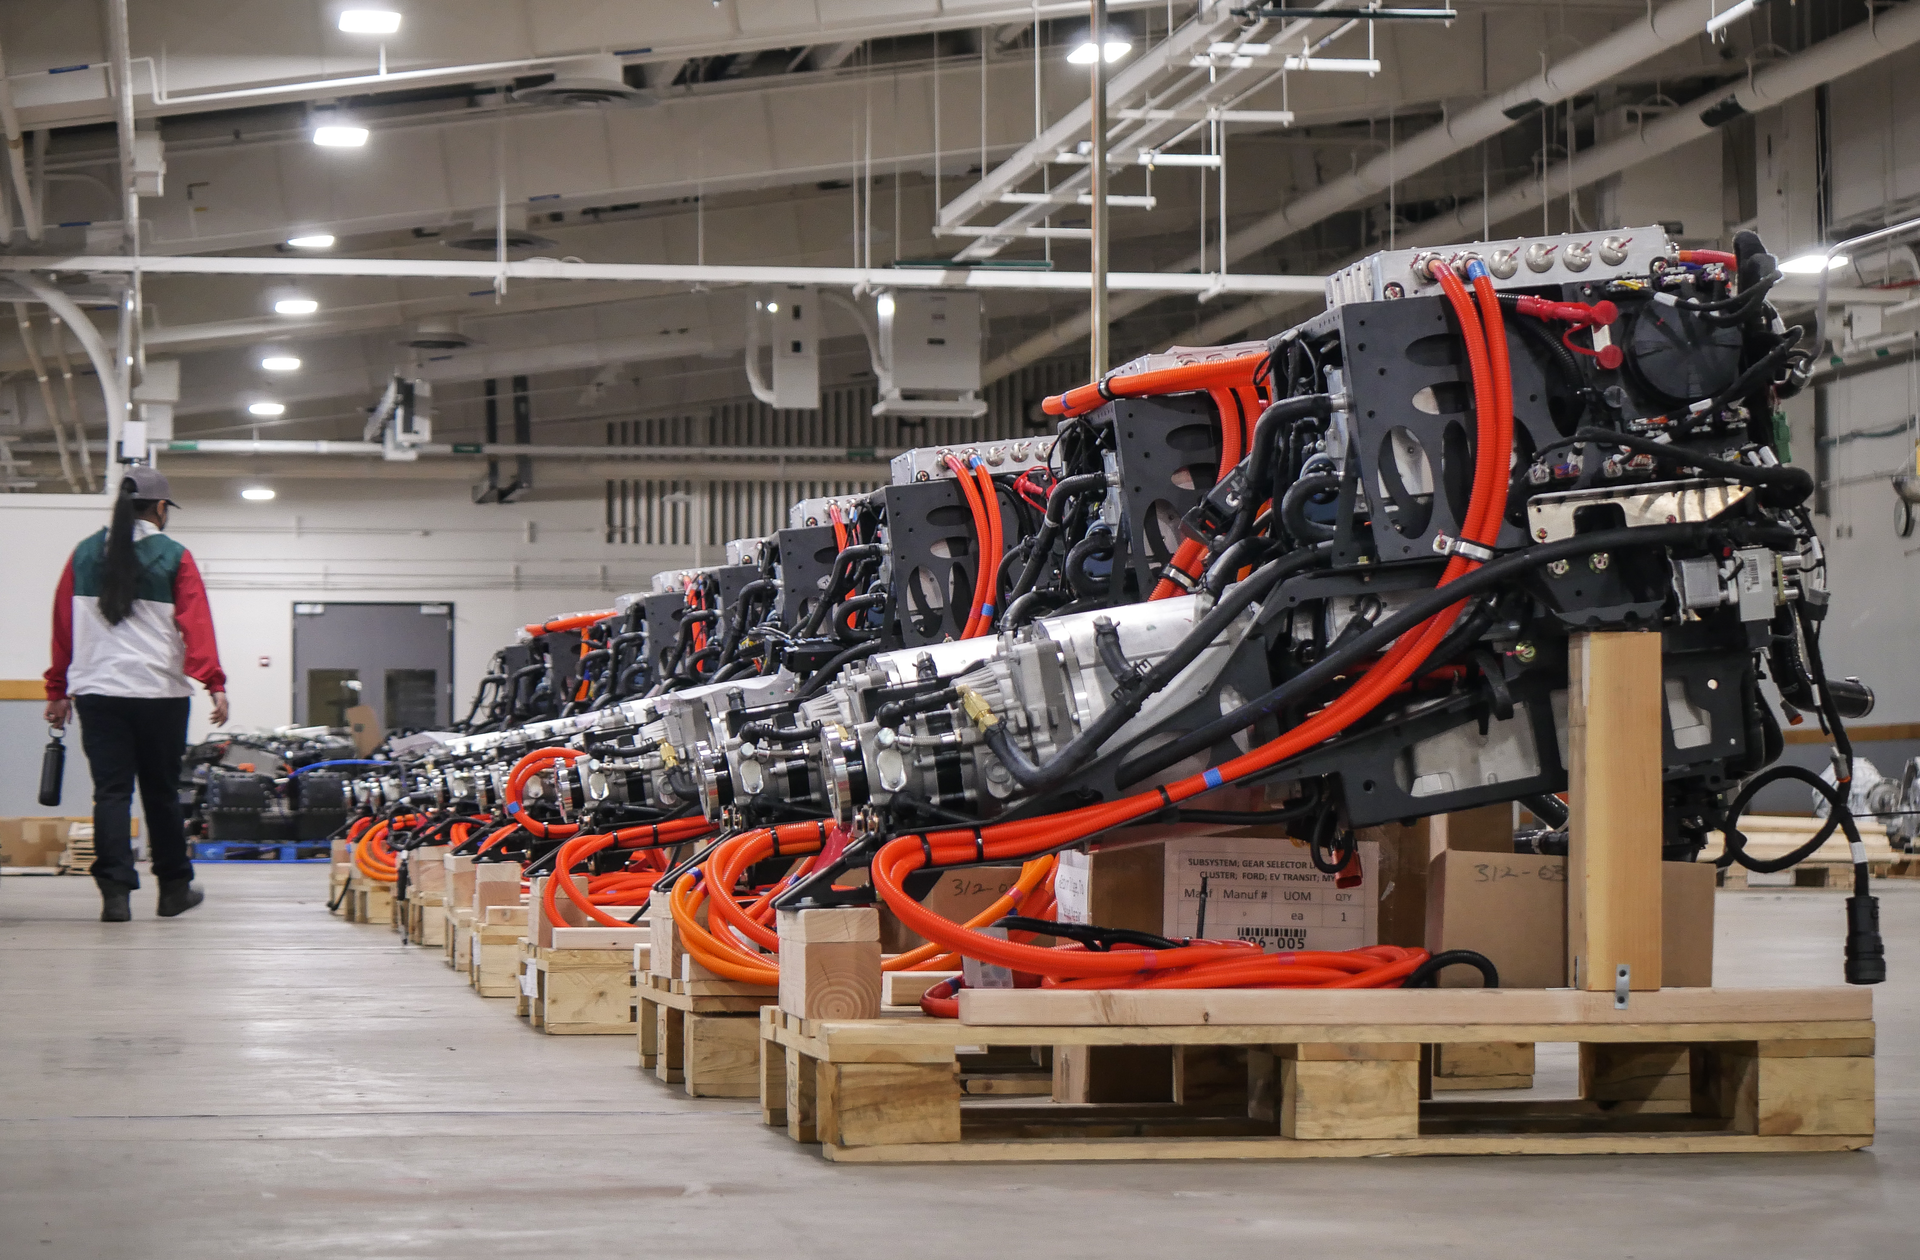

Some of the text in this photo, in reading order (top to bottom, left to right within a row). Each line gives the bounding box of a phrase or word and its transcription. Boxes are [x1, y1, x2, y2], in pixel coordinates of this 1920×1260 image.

[1188, 858, 1239, 868] SUBSYSTEM;
[1242, 860, 1264, 868] GEAR
[1266, 861, 1307, 869] SELECTOR
[1199, 871, 1238, 880] CLUSTER;
[1242, 872, 1267, 881] FORD;
[1269, 873, 1280, 881] EV
[1283, 873, 1320, 883] TRANSIT;
[952, 878, 1016, 897] 312-0
[1223, 889, 1268, 900] Manuf #
[1283, 891, 1312, 901] UOM
[1335, 893, 1352, 902] QTY
[1291, 912, 1304, 921] ea
[1340, 912, 1347, 922] 1
